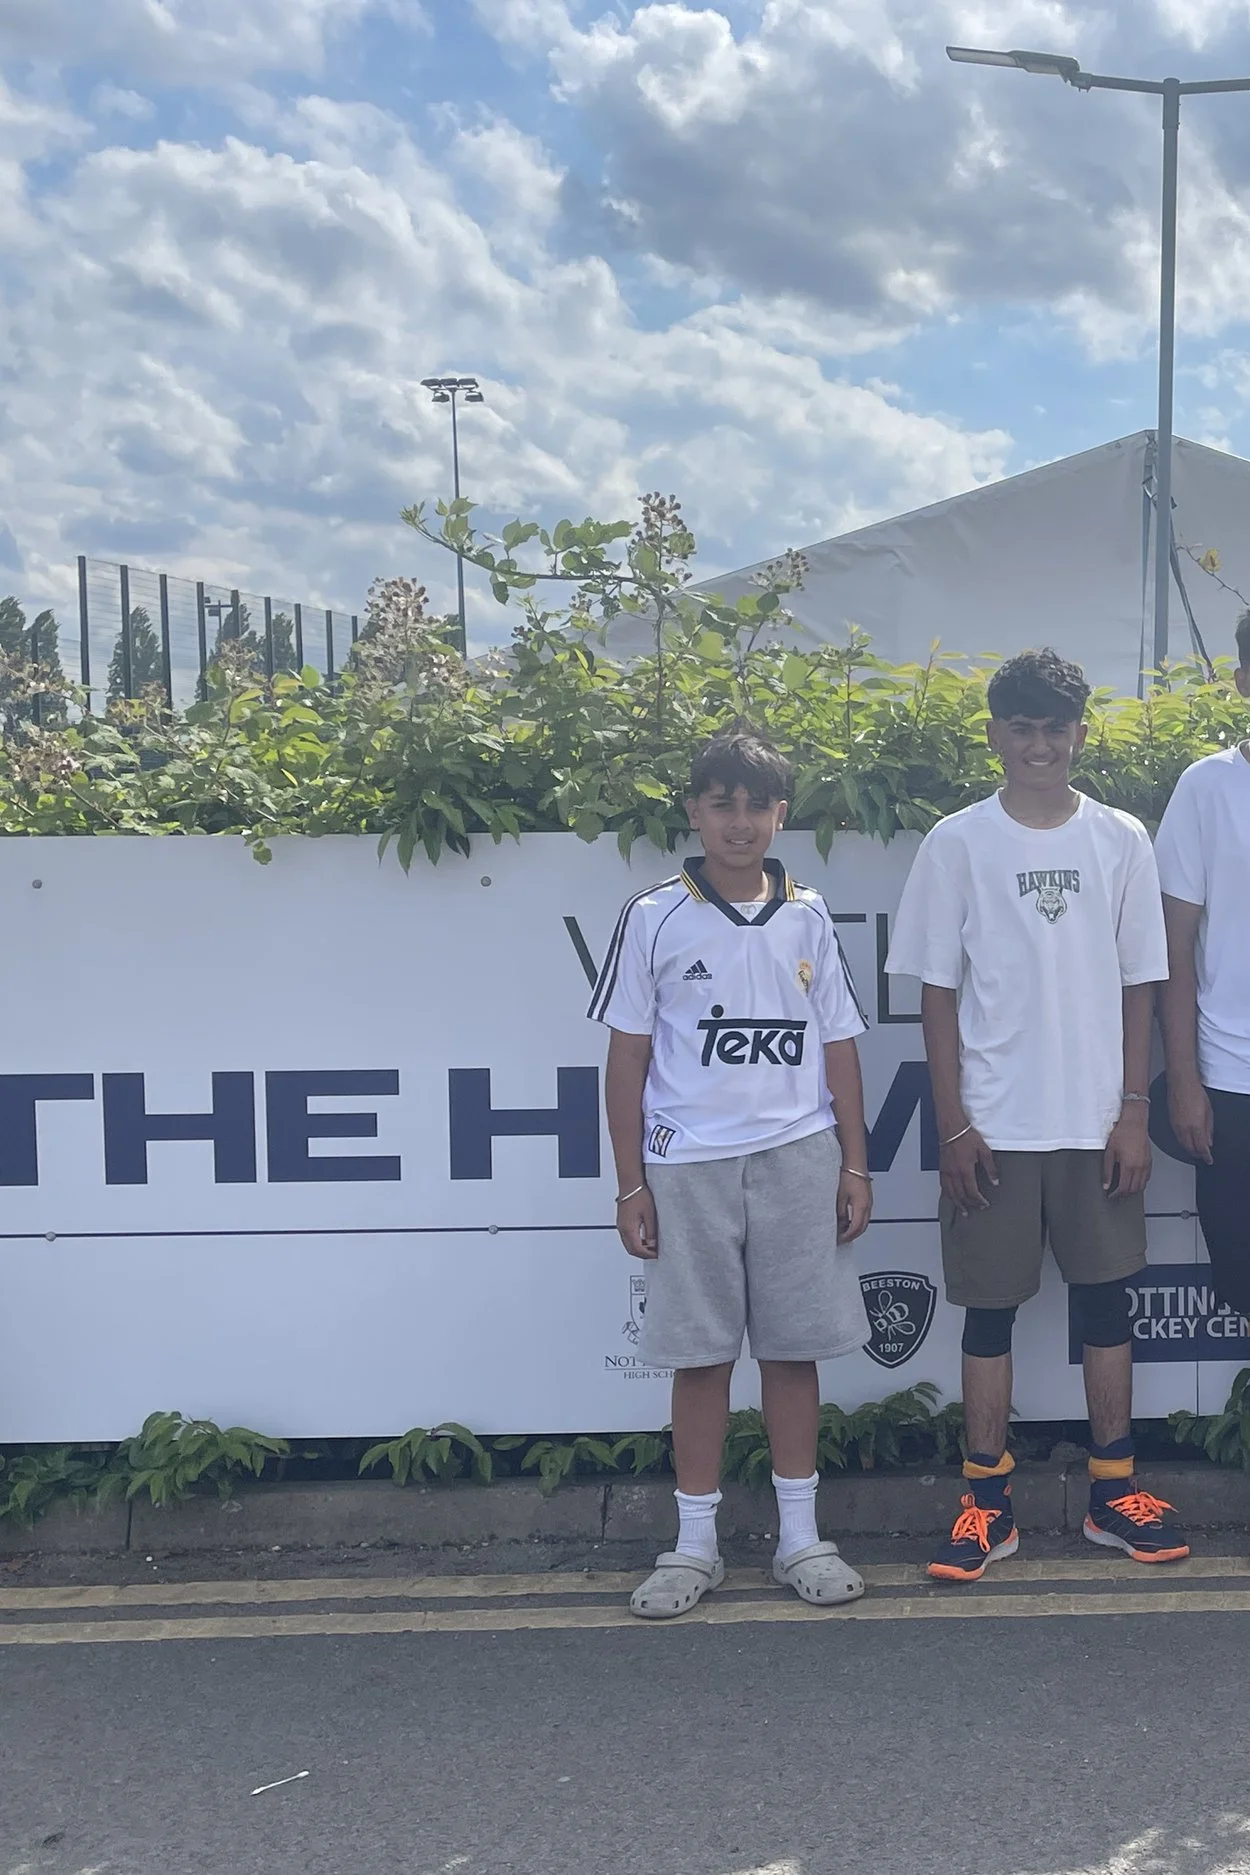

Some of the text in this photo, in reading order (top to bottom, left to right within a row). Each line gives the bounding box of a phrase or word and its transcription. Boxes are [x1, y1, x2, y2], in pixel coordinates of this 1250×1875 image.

[1016, 870, 1080, 897] HAWKINS
[682, 972, 713, 981] adidas
[0, 1067, 401, 1186] THE
[861, 1278, 920, 1293] BEESTON
[1131, 1316, 1250, 1340] CKEY CEN
[879, 1342, 904, 1353] 1907
[623, 1370, 651, 1380] HIGH
